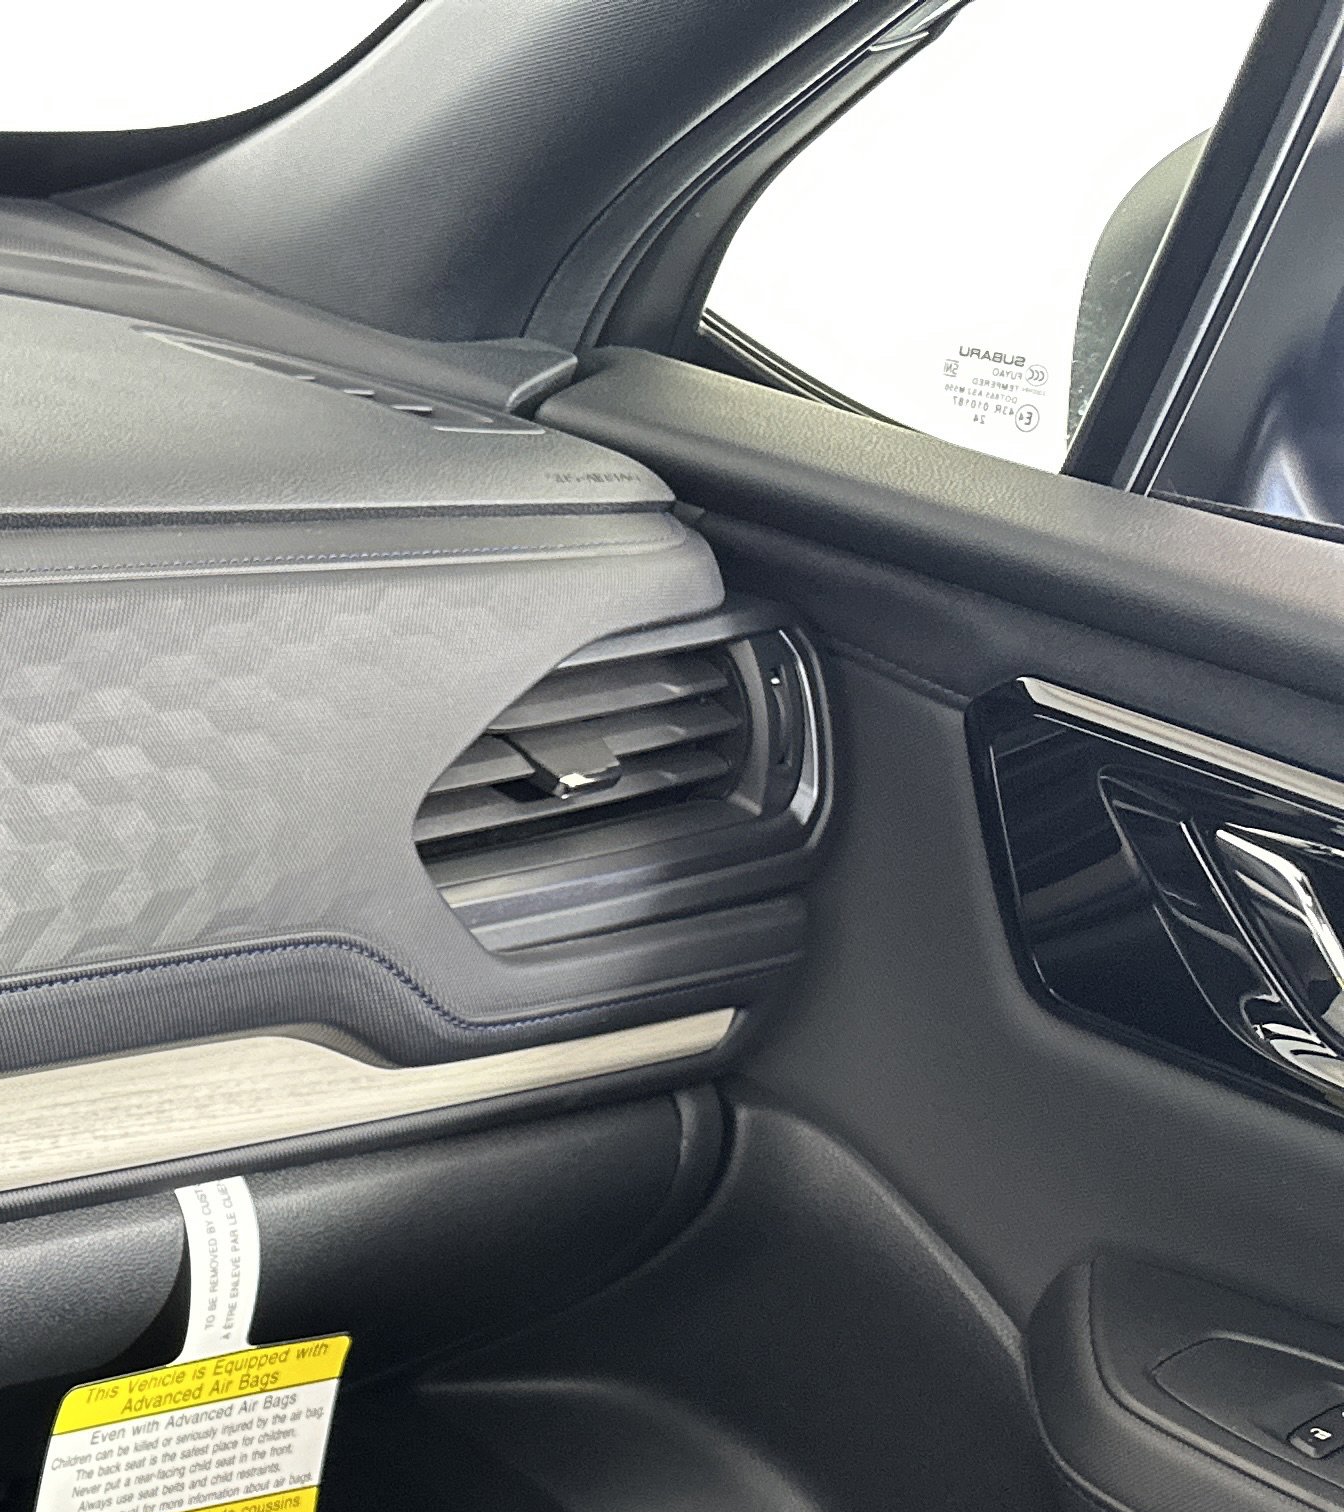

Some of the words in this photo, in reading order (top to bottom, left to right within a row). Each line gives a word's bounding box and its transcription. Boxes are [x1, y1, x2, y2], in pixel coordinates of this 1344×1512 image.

[194, 1184, 212, 1215] CUST
[205, 1220, 217, 1234] BY
[226, 1212, 238, 1226] LE
[230, 1229, 241, 1253] PAR
[208, 1237, 220, 1294] REMOVED
[208, 1295, 218, 1312] BE
[204, 1314, 216, 1331] TO
[86, 1386, 119, 1403] This
[129, 1371, 186, 1393] Vehicle
[192, 1366, 206, 1380] is
[213, 1349, 290, 1376] Equipped
[296, 1343, 328, 1359] with
[121, 1384, 203, 1414] Advanced
[208, 1380, 233, 1396] Air
[238, 1371, 279, 1395] Bags
[90, 1428, 126, 1445] Even
[132, 1420, 159, 1436] with
[165, 1404, 233, 1429] Advanced
[238, 1400, 258, 1414] Air
[263, 1393, 297, 1409] Bags
[51, 1454, 92, 1470] Children
[95, 1449, 114, 1461] can
[117, 1446, 130, 1456] be
[162, 1437, 173, 1447] or
[176, 1427, 217, 1445] seriously
[221, 1419, 253, 1435] injured
[256, 1417, 268, 1428] by
[272, 1414, 287, 1425] the
[290, 1410, 302, 1421] air
[305, 1407, 324, 1419] bag.
[76, 1469, 94, 1480] The
[97, 1462, 121, 1477] back
[124, 1457, 146, 1471] seat
[149, 1456, 158, 1465] is
[161, 1452, 176, 1463] the
[180, 1444, 209, 1459] safest
[212, 1440, 238, 1455] place
[242, 1436, 254, 1446] for
[159, 1498, 184, 1511] more
[188, 1487, 239, 1505] information
[243, 1480, 270, 1494] about
[273, 1477, 286, 1488] air
